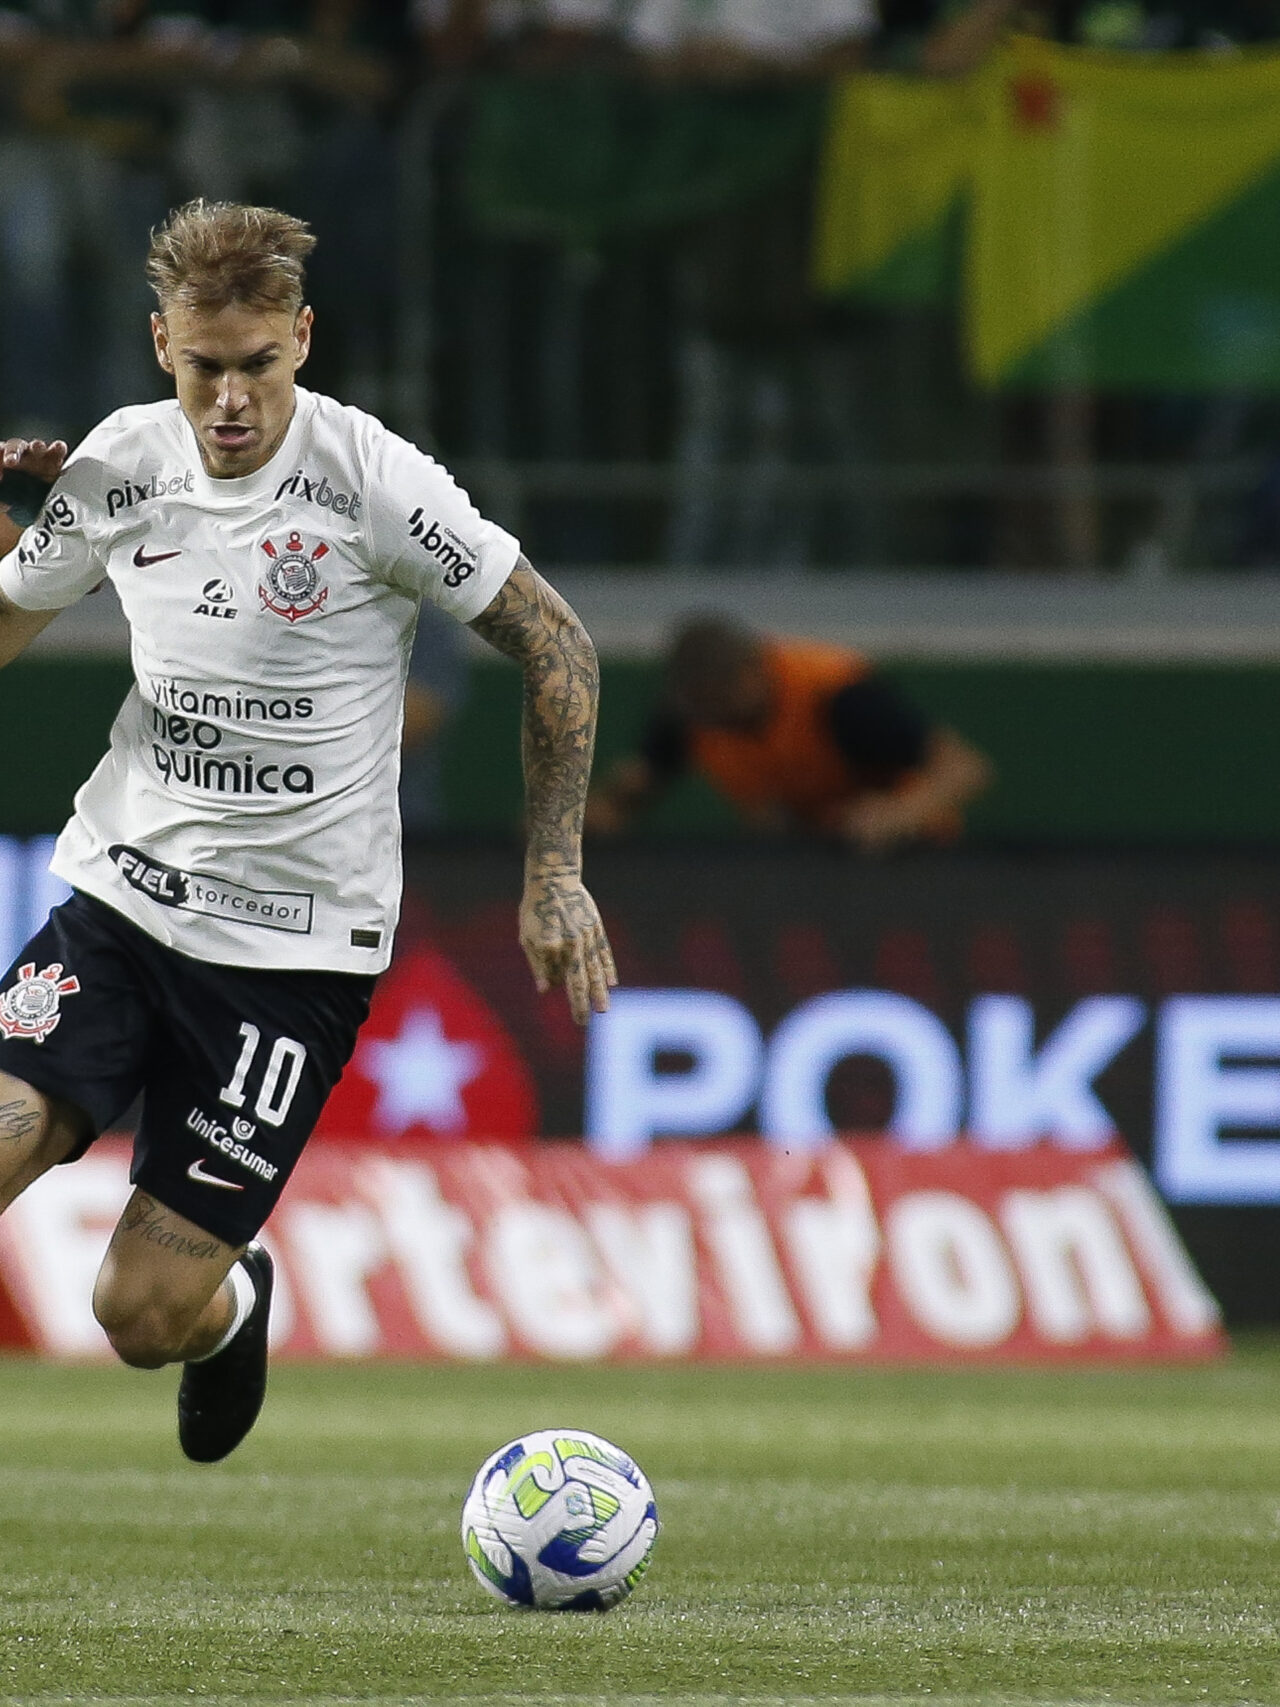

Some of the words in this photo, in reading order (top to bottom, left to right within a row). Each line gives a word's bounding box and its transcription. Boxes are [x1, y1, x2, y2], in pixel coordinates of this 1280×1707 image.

[106, 470, 195, 518] pixbet
[420, 520, 476, 588] bmg
[193, 602, 238, 620] ALE
[150, 679, 314, 721] vitaminas
[152, 706, 222, 750] neo
[117, 851, 175, 898] FIEL
[196, 881, 302, 921] torcedor
[219, 1021, 308, 1127] 10
[186, 1106, 279, 1182] UniCesumar
